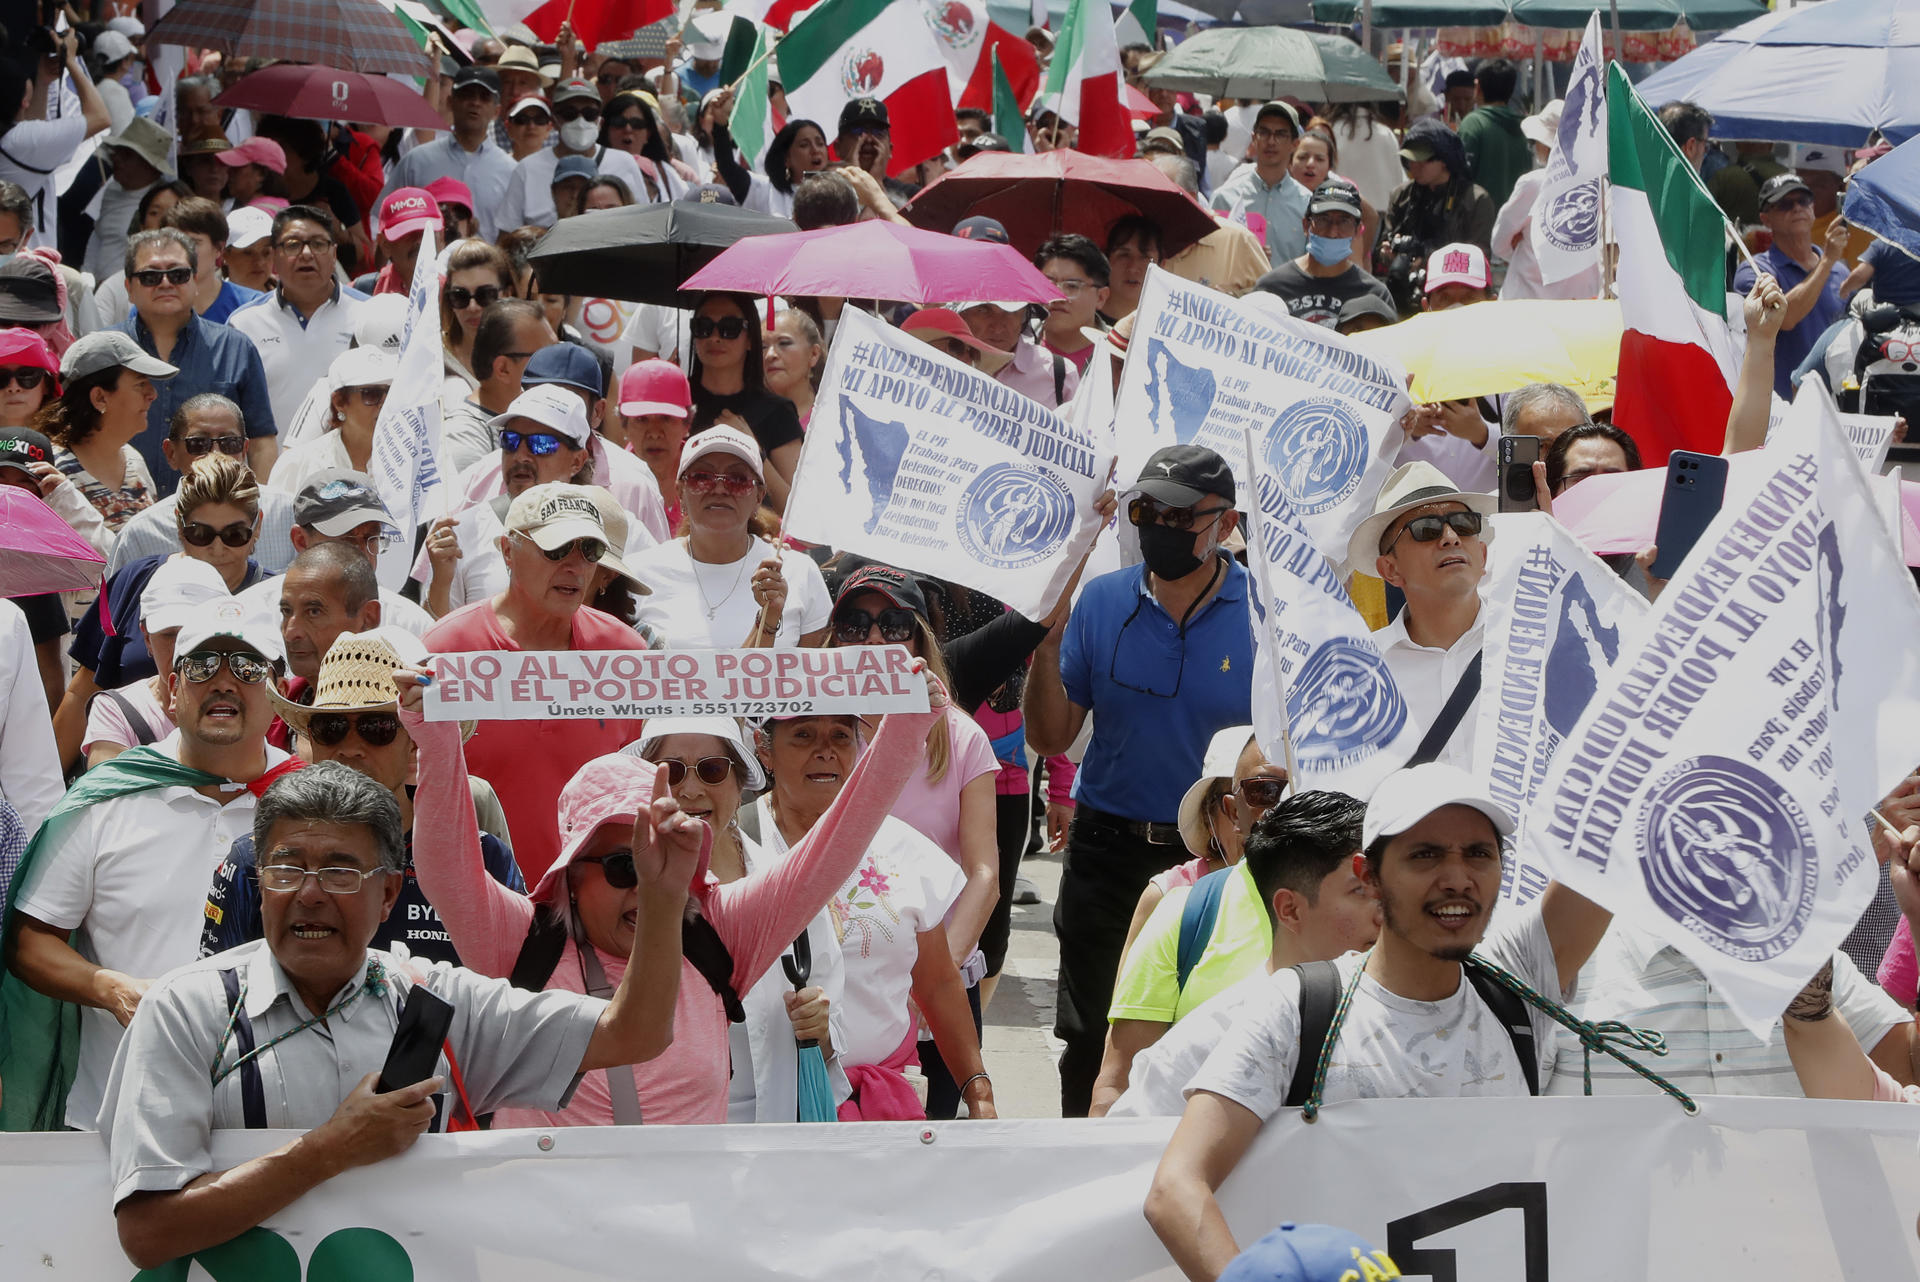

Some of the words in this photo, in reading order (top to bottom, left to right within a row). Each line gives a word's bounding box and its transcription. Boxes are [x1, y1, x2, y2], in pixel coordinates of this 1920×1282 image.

[1154, 311, 1174, 337] MI
[1176, 321, 1238, 359] APOYO
[1240, 341, 1258, 367] AL
[1261, 347, 1318, 383] PODER
[1318, 372, 1399, 414] JUDICIAL
[851, 340, 1097, 450] #INDEPENDENCIAJUDICIAL
[840, 364, 861, 392] MI
[864, 373, 928, 411] APOYO
[930, 394, 957, 419] AL
[959, 405, 1022, 450] PODER
[1020, 427, 1097, 480] JUDICIAL
[908, 442, 949, 464] Trabaja
[915, 429, 929, 442] EL
[929, 434, 950, 449] PJF
[900, 458, 946, 479] defender
[948, 472, 963, 485] tus
[1045, 468, 1072, 496] SOMOS
[891, 492, 907, 508] Hoy
[909, 497, 927, 511] nos
[926, 498, 948, 516] toca
[956, 490, 972, 524] PODER
[1313, 473, 1362, 514] FEDERACIÓN
[541, 499, 558, 521] SAN
[883, 509, 940, 531] defendernos
[875, 524, 900, 541] para
[900, 529, 950, 552] defenderte
[957, 523, 984, 563] JUDICIAL
[998, 559, 1011, 569] LA
[1012, 537, 1064, 569] FEDERACIÓN
[1283, 543, 1316, 579] AL
[1283, 632, 1311, 657] ¡Para
[435, 655, 501, 681] NO
[517, 655, 569, 680] AL
[580, 653, 699, 680] VOTO
[715, 649, 912, 679] POPULAR
[440, 679, 495, 703] EN
[511, 679, 555, 702] EL
[568, 678, 708, 702] PODER
[721, 673, 911, 701] JUDICIAL
[547, 701, 606, 716] Únete
[611, 703, 673, 716] Whats
[692, 700, 814, 715] 5551723702
[217, 859, 238, 882] bil
